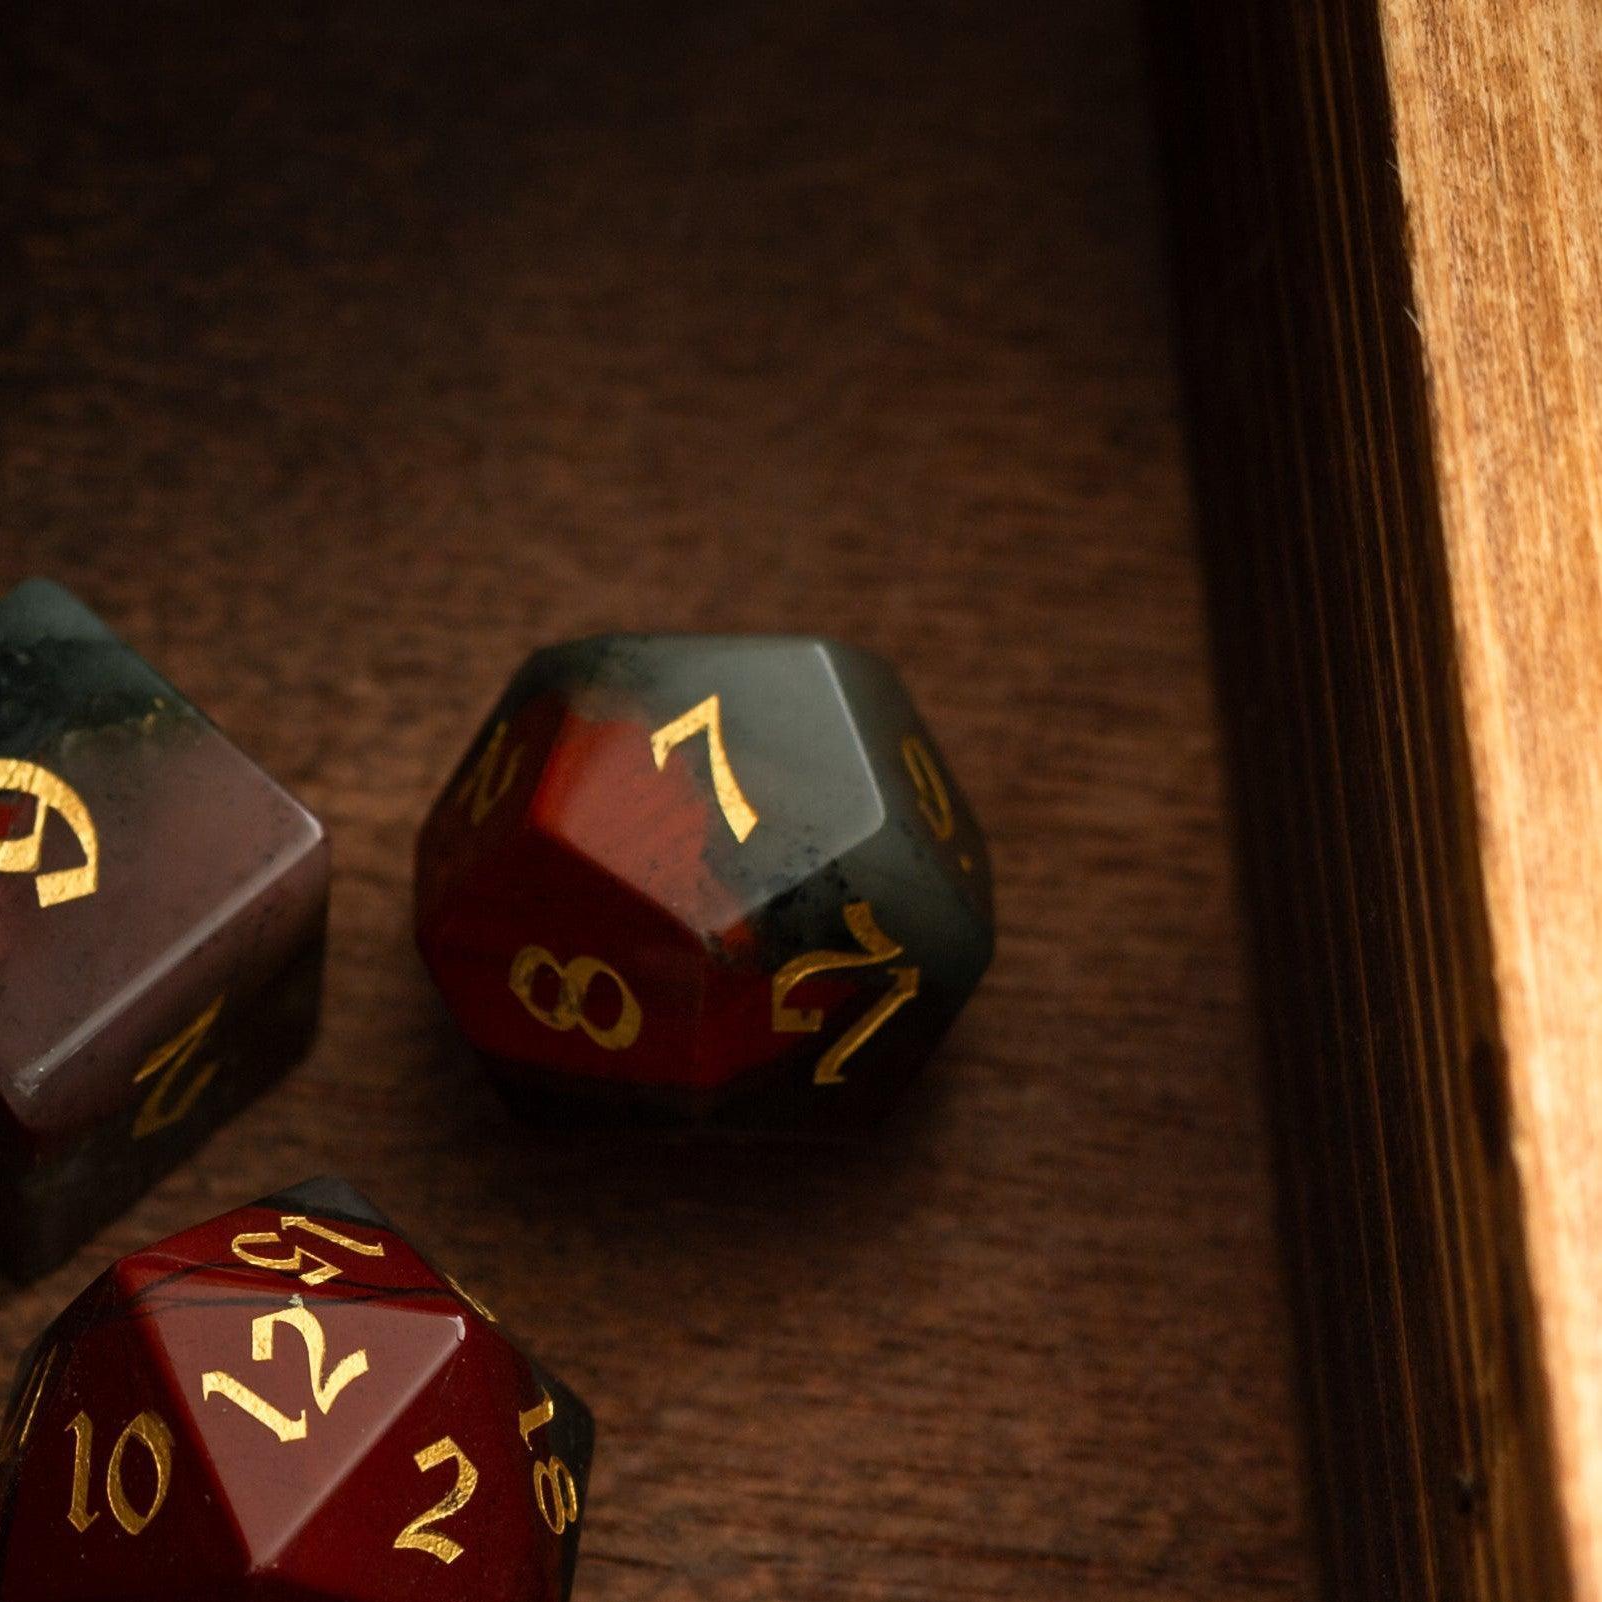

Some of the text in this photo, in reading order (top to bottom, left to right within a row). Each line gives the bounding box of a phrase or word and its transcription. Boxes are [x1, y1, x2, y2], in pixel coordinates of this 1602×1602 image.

[650, 694, 759, 844] 7
[509, 944, 644, 1052] 8
[772, 901, 921, 1086] 12
[231, 1215, 386, 1287] 15
[201, 1305, 370, 1444] 12
[64, 1409, 174, 1536] 10
[392, 1435, 480, 1566] 2
[518, 1392, 578, 1536] 18
